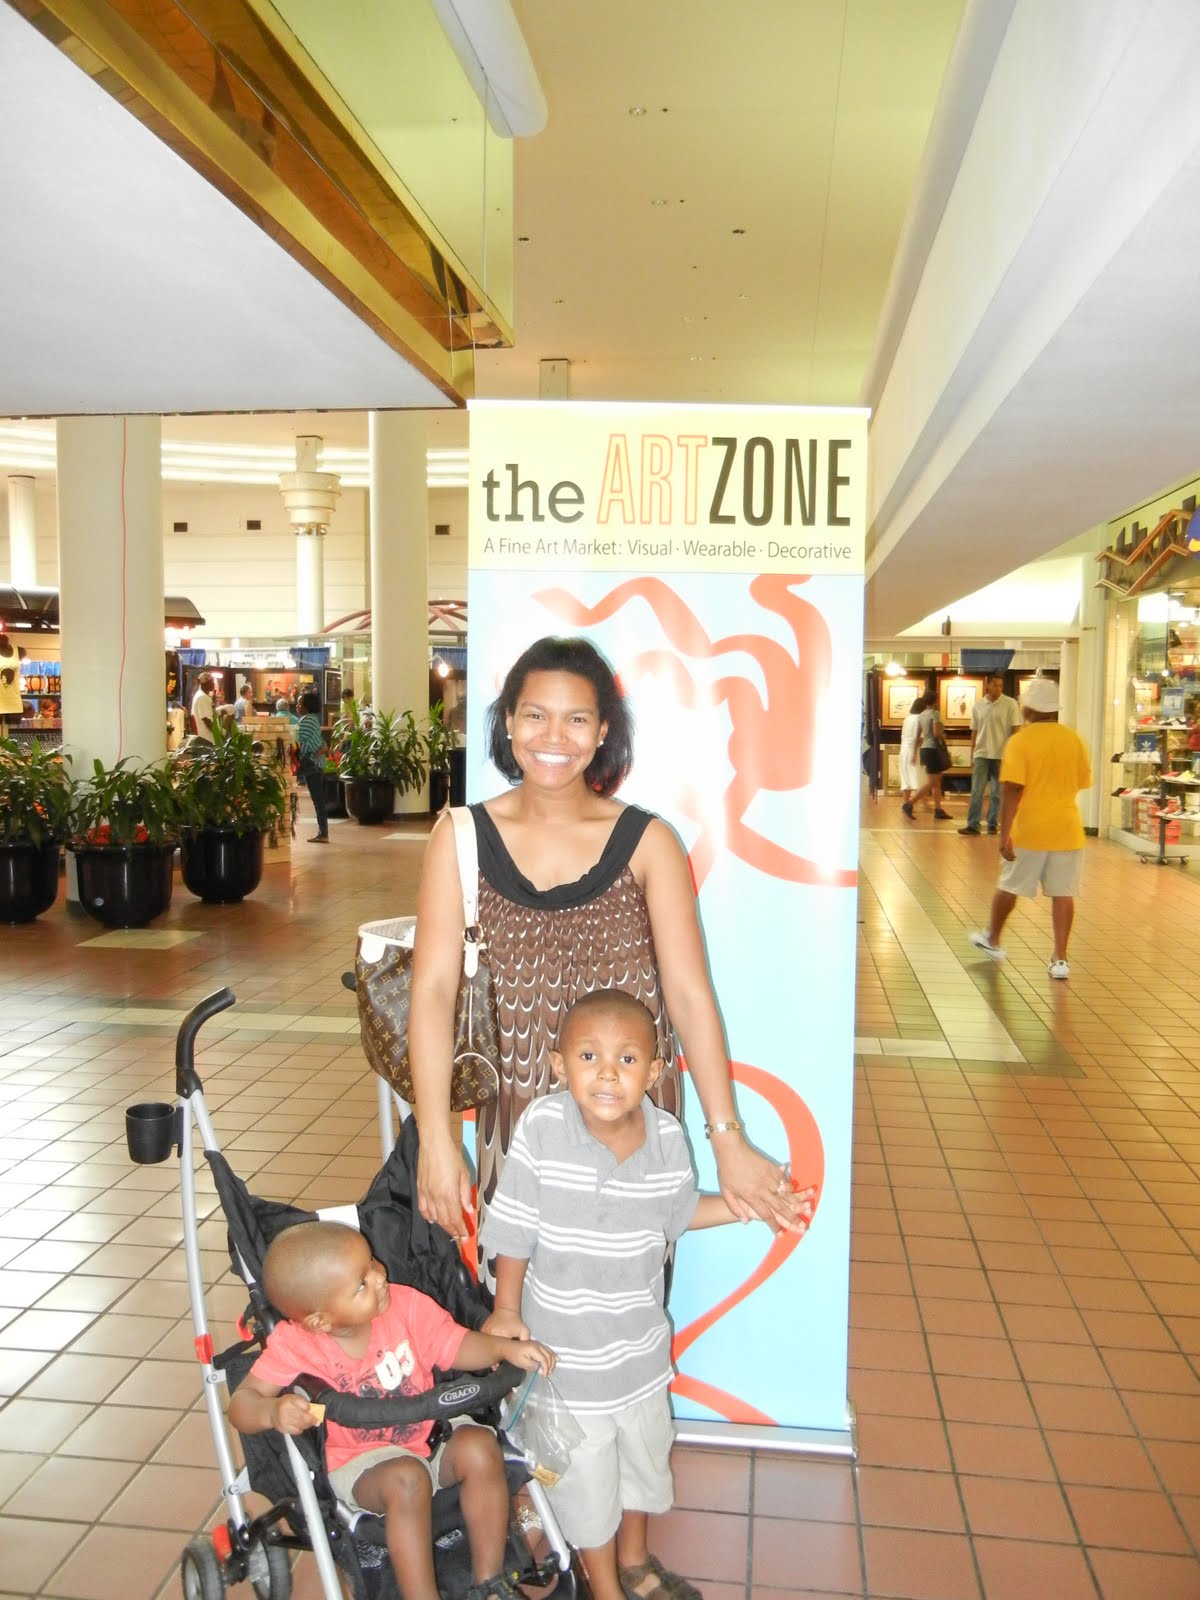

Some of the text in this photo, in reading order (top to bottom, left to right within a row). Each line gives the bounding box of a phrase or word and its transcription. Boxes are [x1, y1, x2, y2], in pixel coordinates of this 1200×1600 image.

[482, 463, 585, 523] the
[483, 537, 852, 559] A Fine Art Market: Visual Wearable Decorative
[444, 1385, 476, 1402] GRACO
